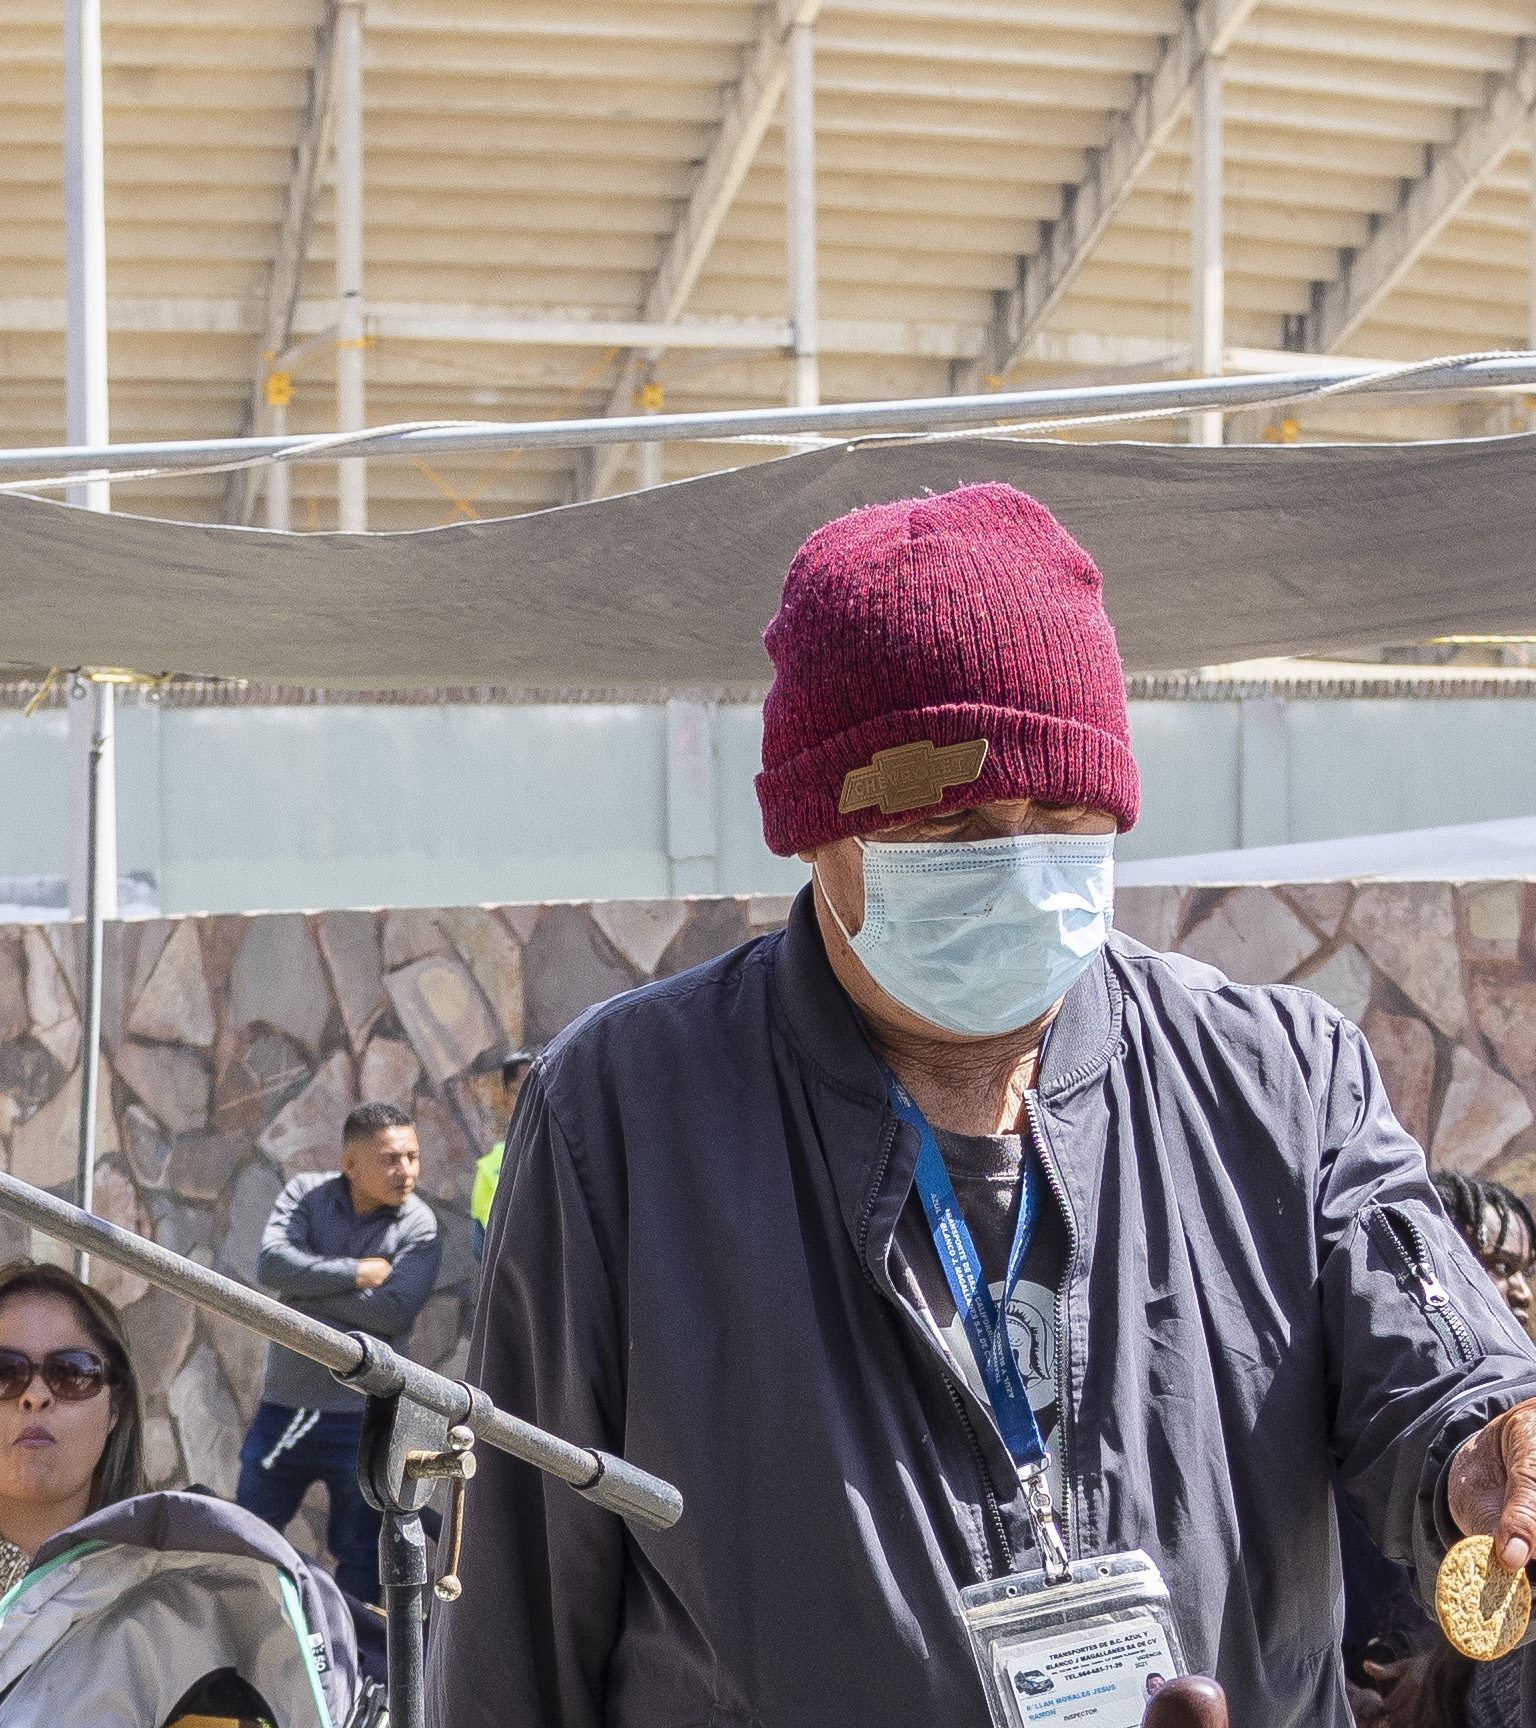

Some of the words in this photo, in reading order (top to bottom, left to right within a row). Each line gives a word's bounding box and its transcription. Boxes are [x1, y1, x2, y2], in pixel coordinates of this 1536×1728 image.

[1045, 1658, 1074, 1671] BLANCO
[1079, 1646, 1126, 1663] MAGALLANES
[1137, 1641, 1147, 1649] DE
[1048, 1643, 1099, 1661] TRANSPORTES
[1098, 1640, 1109, 1649] DE
[1124, 1631, 1142, 1642] AZUL
[1142, 1630, 1149, 1638] Y
[1063, 1708, 1099, 1722] INSPECTOR
